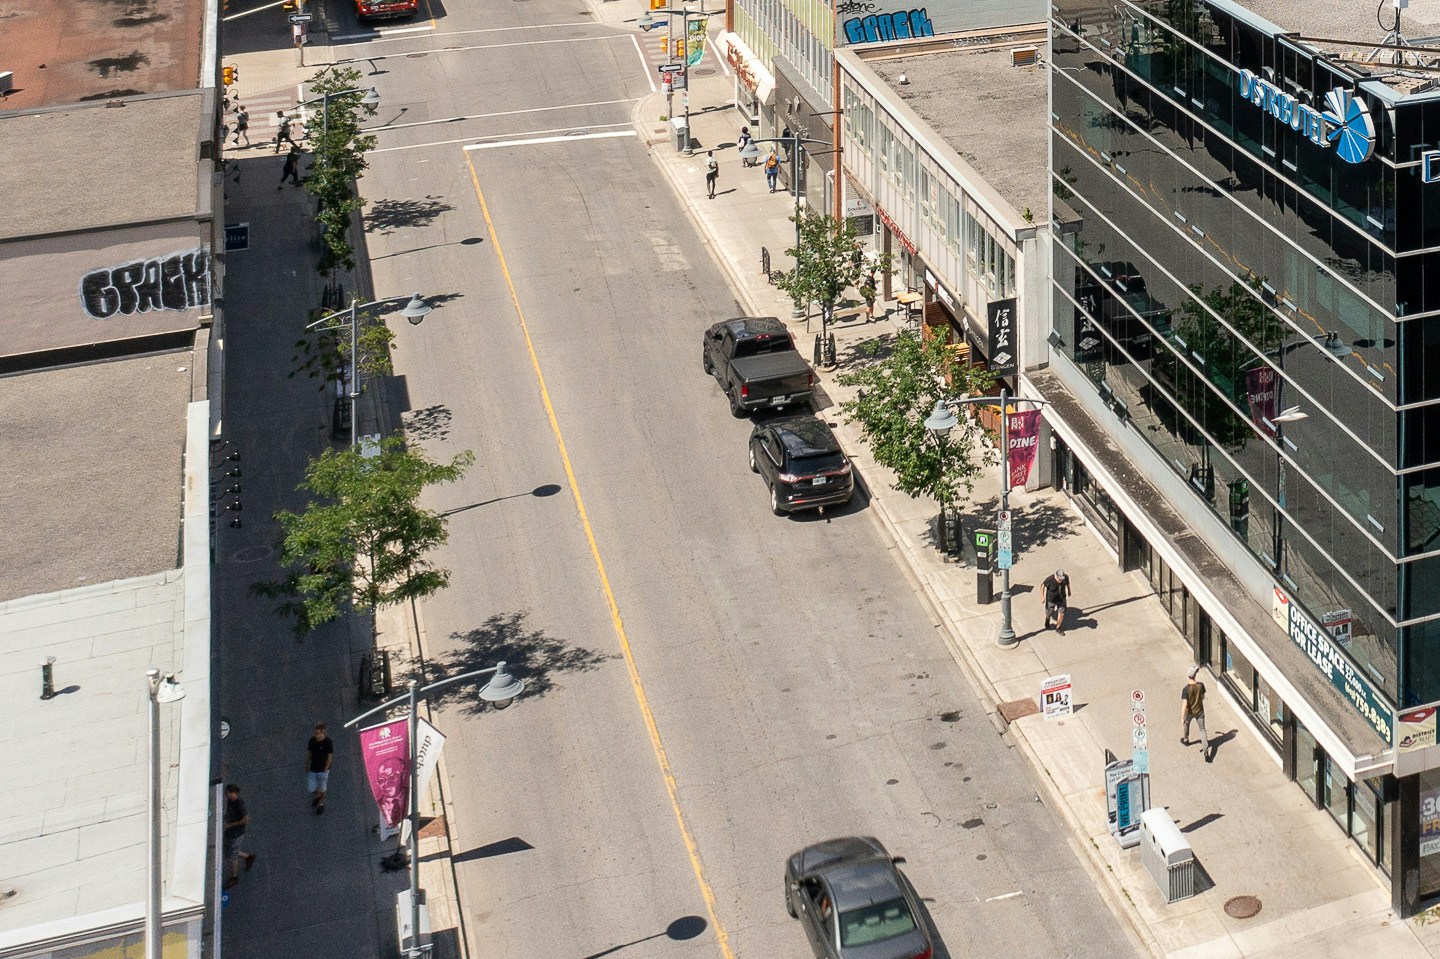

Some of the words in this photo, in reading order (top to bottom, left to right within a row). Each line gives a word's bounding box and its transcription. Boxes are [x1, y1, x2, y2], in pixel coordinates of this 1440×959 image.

[689, 34, 707, 42] SHOP
[1240, 68, 1331, 148] DISTRIBUTEL
[1010, 436, 1036, 449] DINE
[1290, 605, 1318, 642] OFFICE
[1317, 634, 1345, 676] SPACE
[1290, 621, 1306, 651] FOR
[1307, 640, 1334, 680] LEASE
[1412, 729, 1435, 739] DISTRICT
[1119, 783, 1129, 811] PRINT
[1119, 812, 1129, 827] WE
